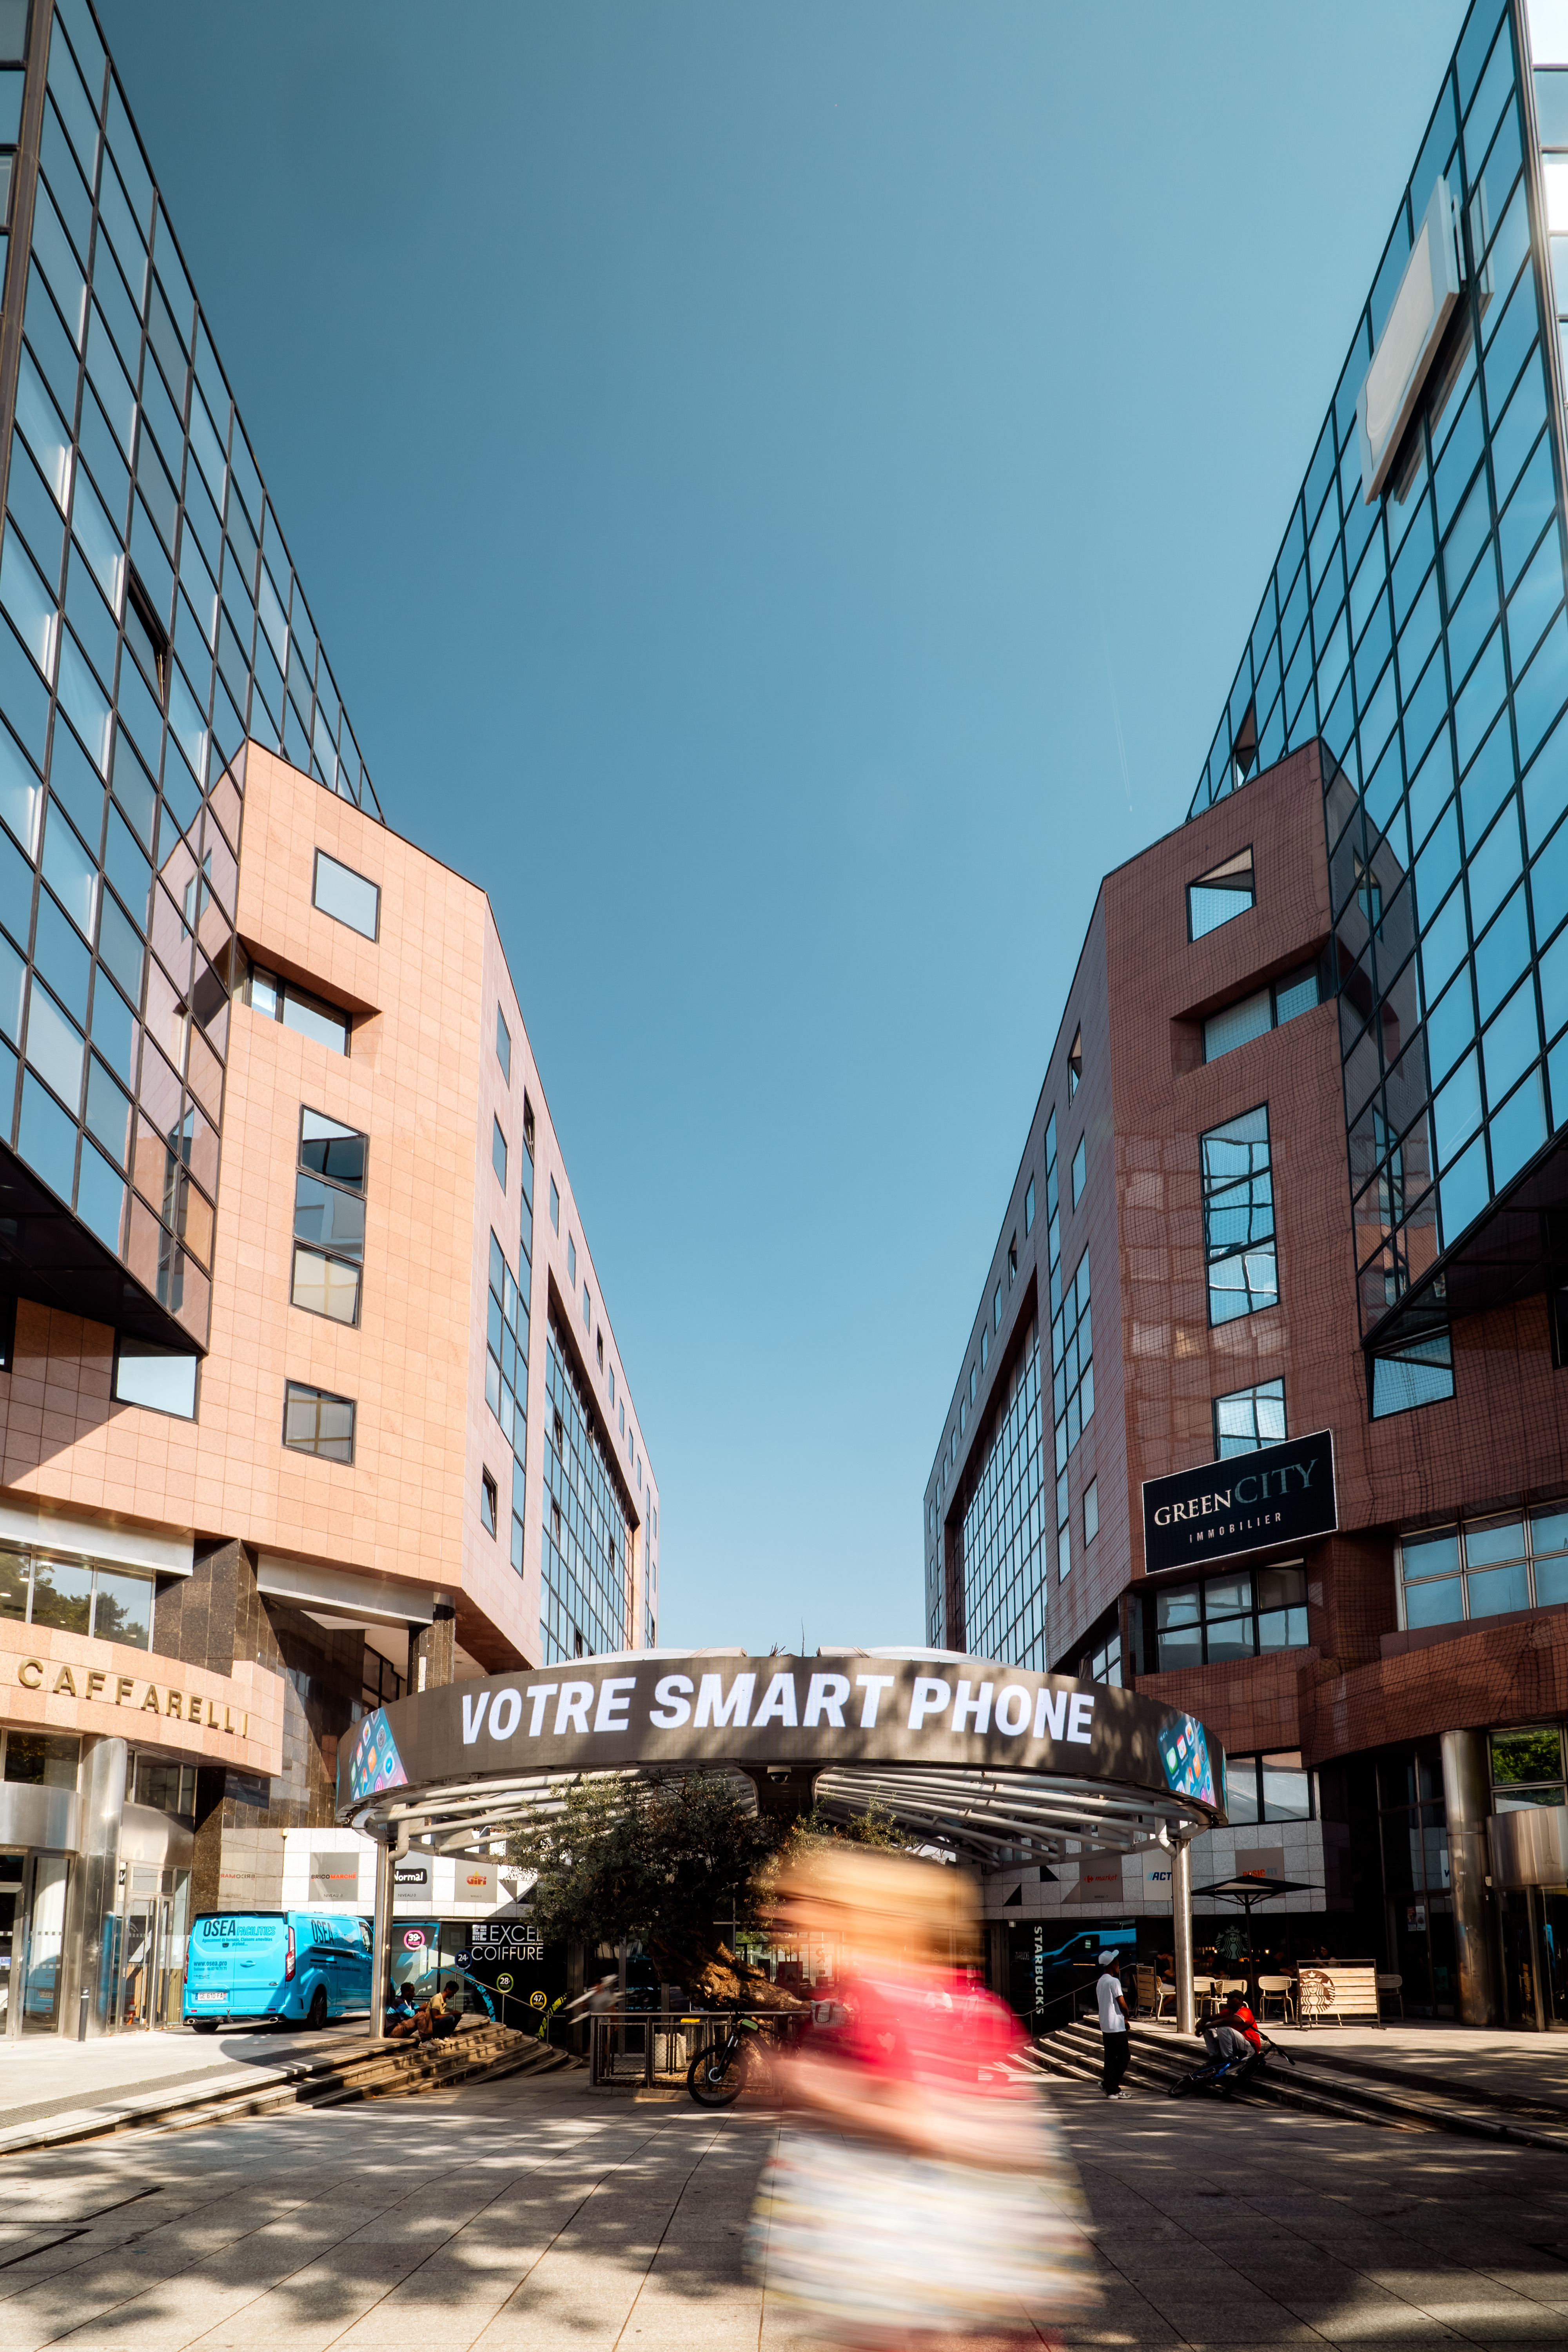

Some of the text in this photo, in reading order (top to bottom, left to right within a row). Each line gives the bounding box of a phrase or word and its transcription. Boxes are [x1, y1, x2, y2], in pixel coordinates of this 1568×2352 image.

[1190, 1512, 1281, 1543] IMMOBILIER
[18, 1658, 248, 1738] CAFFARELLI
[462, 1672, 1095, 1745] VOTRE SMART PHONE
[311, 1872, 356, 1881] BRICOMARCHÉ
[394, 1871, 423, 1881] Normal
[203, 1920, 276, 1936] OSEA FACILITIES
[311, 1919, 334, 1945] OSEA
[472, 1946, 543, 1960] COIFFURE
[1034, 1926, 1044, 2014] STARBUCKS
